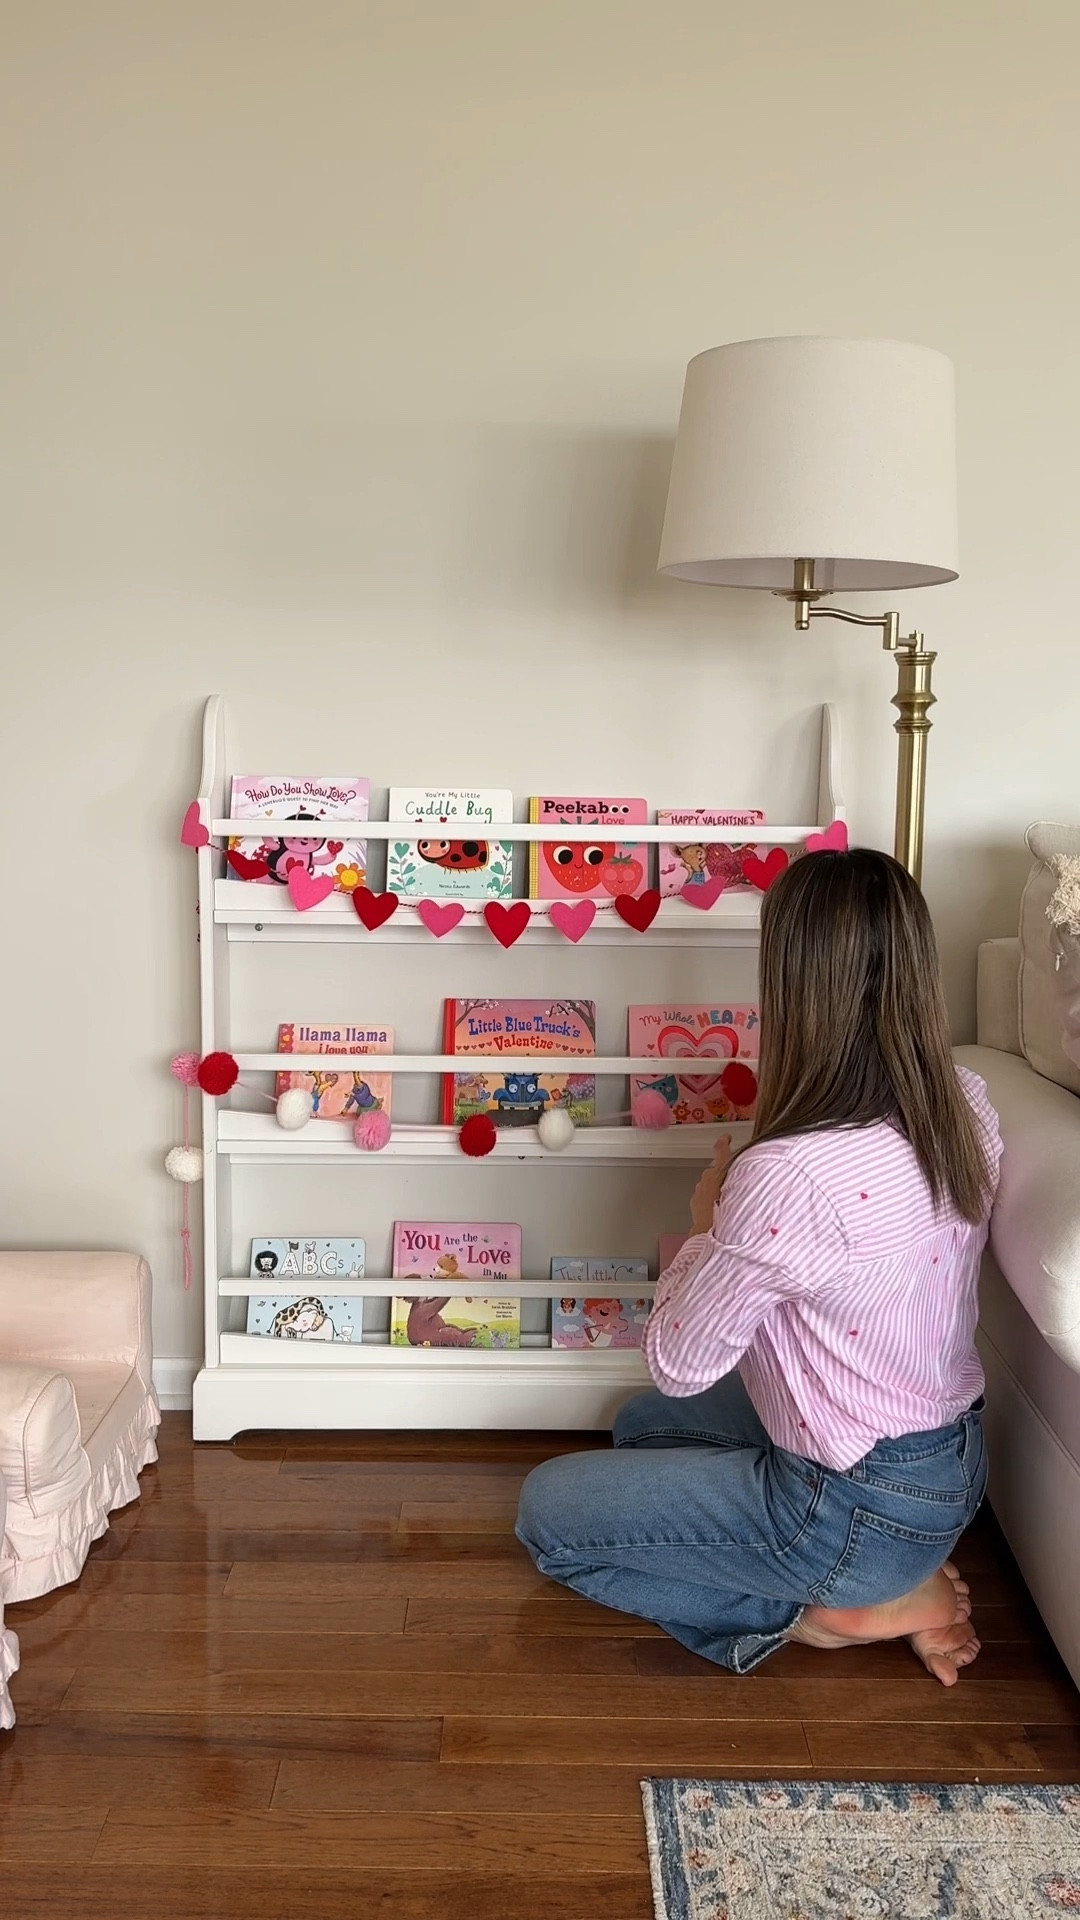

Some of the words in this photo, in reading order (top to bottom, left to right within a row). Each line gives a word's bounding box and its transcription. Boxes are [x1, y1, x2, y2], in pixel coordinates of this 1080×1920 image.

[245, 789, 270, 802] How
[270, 785, 283, 797] Do
[283, 782, 301, 796] You
[302, 782, 328, 797] Show
[326, 786, 357, 805] Love?
[448, 791, 458, 799] My
[460, 791, 481, 799] Little
[405, 800, 458, 816] Cuddle
[466, 800, 493, 823] Bug
[543, 800, 630, 815] Peekaboo
[601, 815, 625, 825] Love
[671, 815, 700, 825] HAPPY
[702, 815, 755, 826] VALENTINE'S
[468, 1018, 502, 1036] Little
[505, 1016, 532, 1033] Blue
[533, 1016, 581, 1038] Truck's
[639, 1015, 661, 1027] My
[664, 1010, 695, 1026] Whole
[696, 1009, 759, 1030] HEART
[300, 1027, 341, 1041] llama
[346, 1028, 387, 1042] llama
[493, 1034, 554, 1051] Valentine
[403, 1230, 441, 1251] You
[444, 1236, 460, 1245] Are
[462, 1233, 478, 1243] the
[278, 1251, 344, 1276] ABCs
[467, 1245, 511, 1265] Love
[483, 1267, 492, 1277] in
